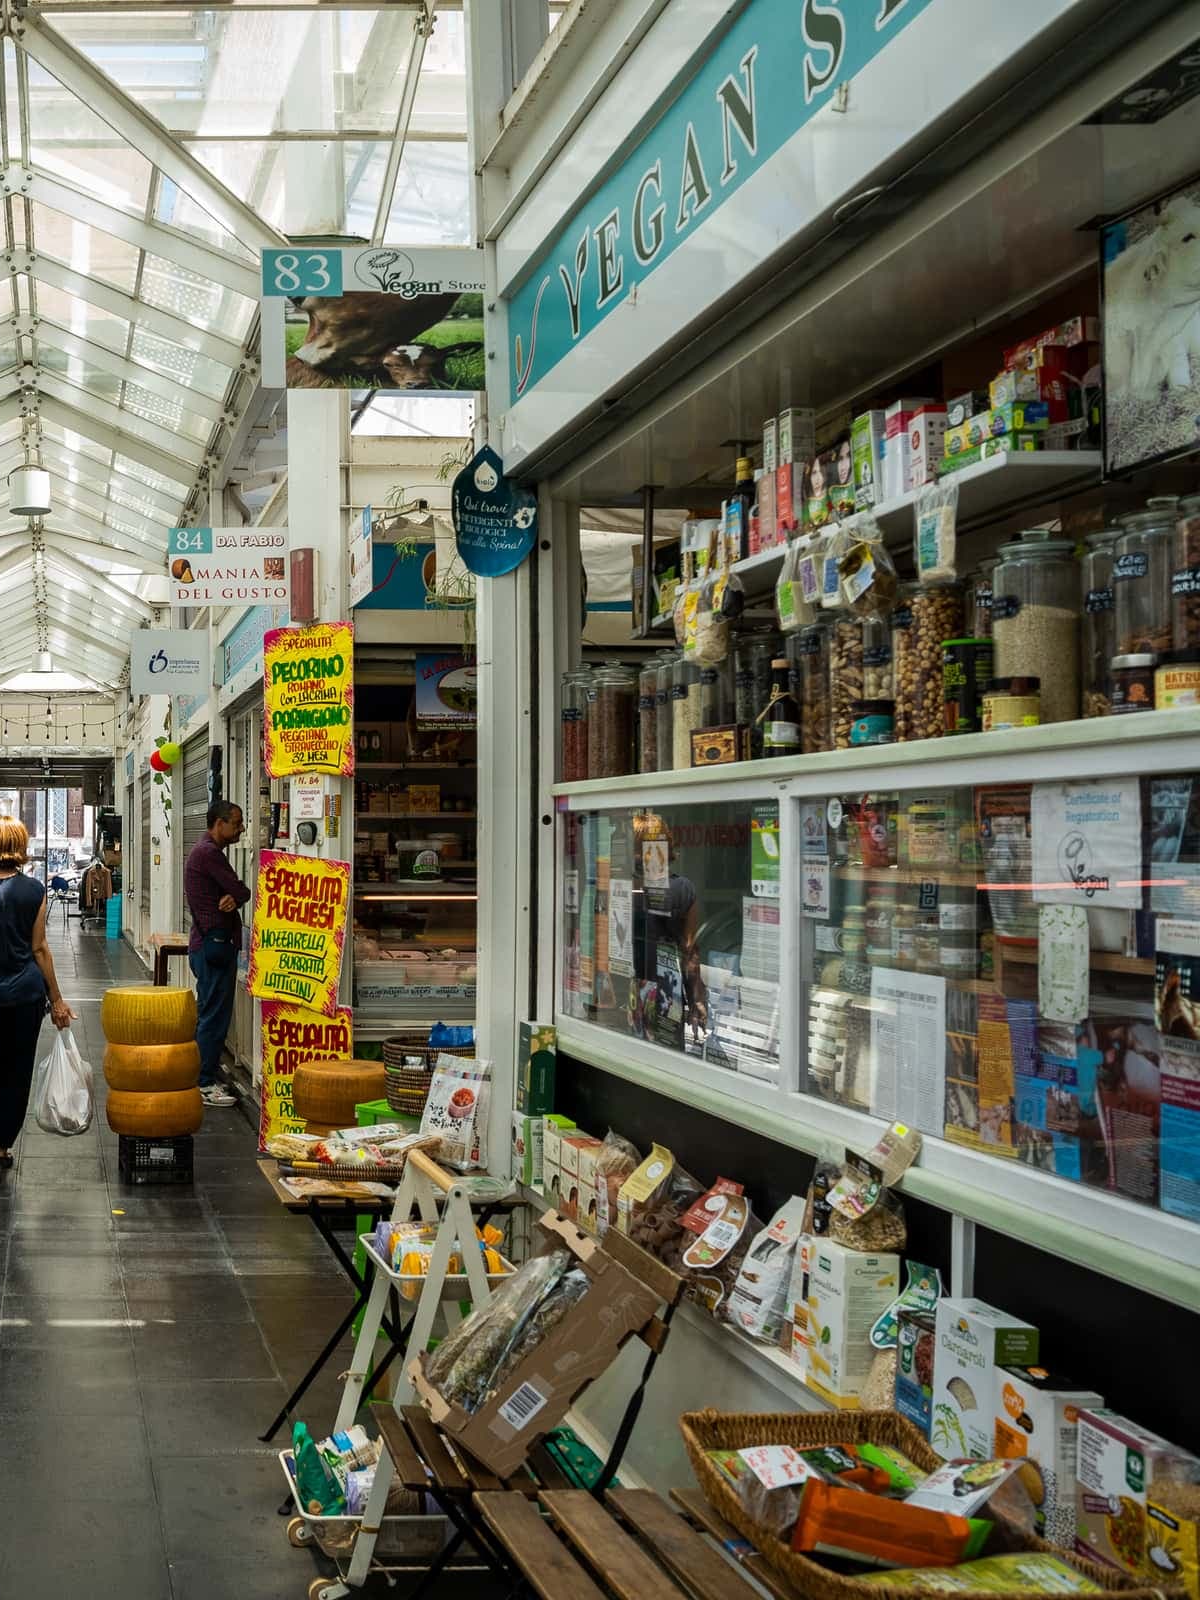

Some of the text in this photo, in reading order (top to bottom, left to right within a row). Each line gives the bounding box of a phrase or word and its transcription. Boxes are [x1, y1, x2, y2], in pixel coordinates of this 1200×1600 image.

[559, 45, 759, 339] VEGAN
[274, 254, 331, 292] 83
[448, 280, 487, 291] Store
[480, 500, 509, 514] trovi
[176, 530, 204, 551] 84
[215, 535, 285, 548] DA FABIO
[196, 568, 261, 580] MANIA
[177, 587, 288, 600] DEL GUSTO
[272, 654, 345, 685] PECORINO
[287, 679, 326, 694] ROMANO
[298, 686, 337, 703] LACRIMA
[272, 706, 351, 731] PARMIGIANO
[280, 728, 328, 743] REGGIANO
[285, 740, 339, 754] STRAVECCHIO
[292, 751, 329, 764] 32 MESI
[266, 894, 336, 930] PUGLIESI
[261, 928, 326, 952] MOZZARELLA
[278, 952, 325, 976] BURRATA
[263, 971, 313, 998] LATTICINI
